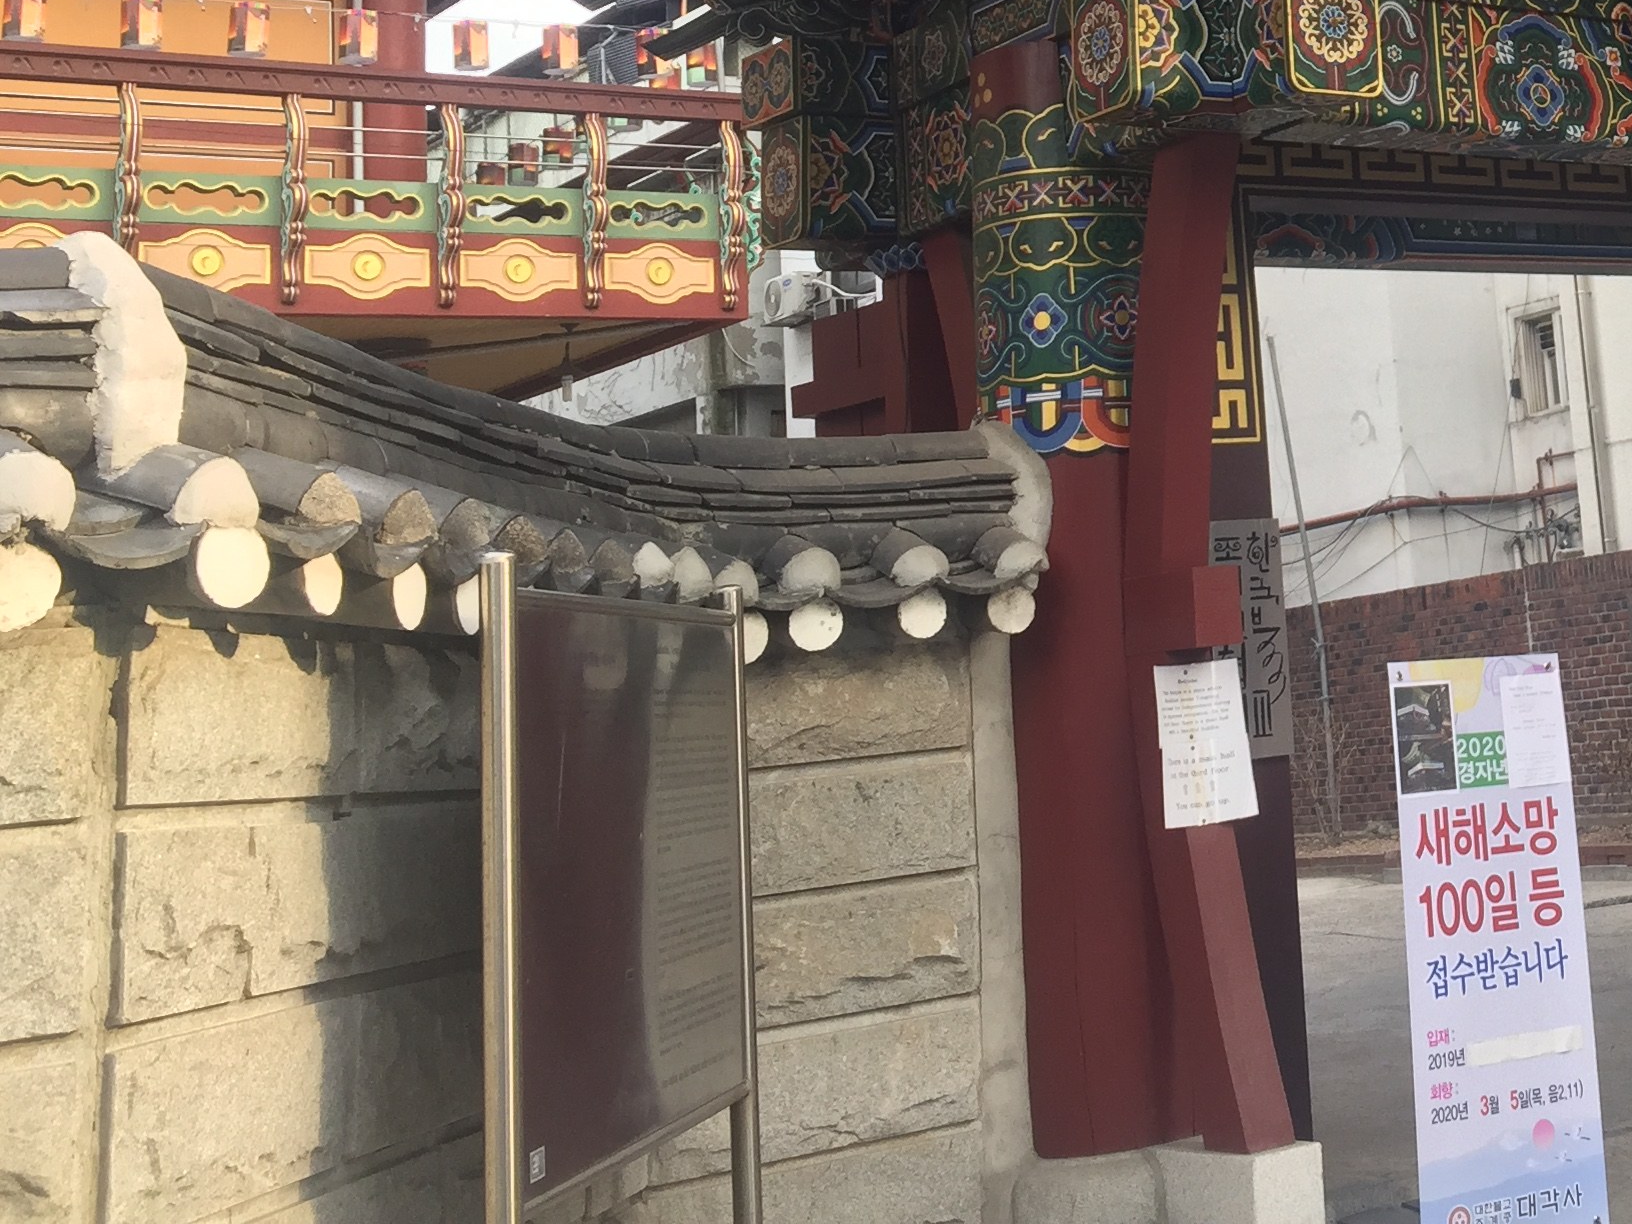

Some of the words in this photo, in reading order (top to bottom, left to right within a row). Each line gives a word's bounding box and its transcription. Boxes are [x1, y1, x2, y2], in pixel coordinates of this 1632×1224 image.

[1456, 735, 1506, 759] 2020
[1458, 758, 1510, 784] 경자년
[1415, 796, 1559, 866] 새해소망
[1419, 870, 1520, 938] 100일
[1529, 867, 1565, 927] 등
[1426, 938, 1569, 1000] 접수받습니다
[1428, 1048, 1466, 1071] 2019년
[1431, 1102, 1469, 1125] 2020년
[1480, 1095, 1500, 1117] 3월
[1516, 1184, 1583, 1218] 대각사
